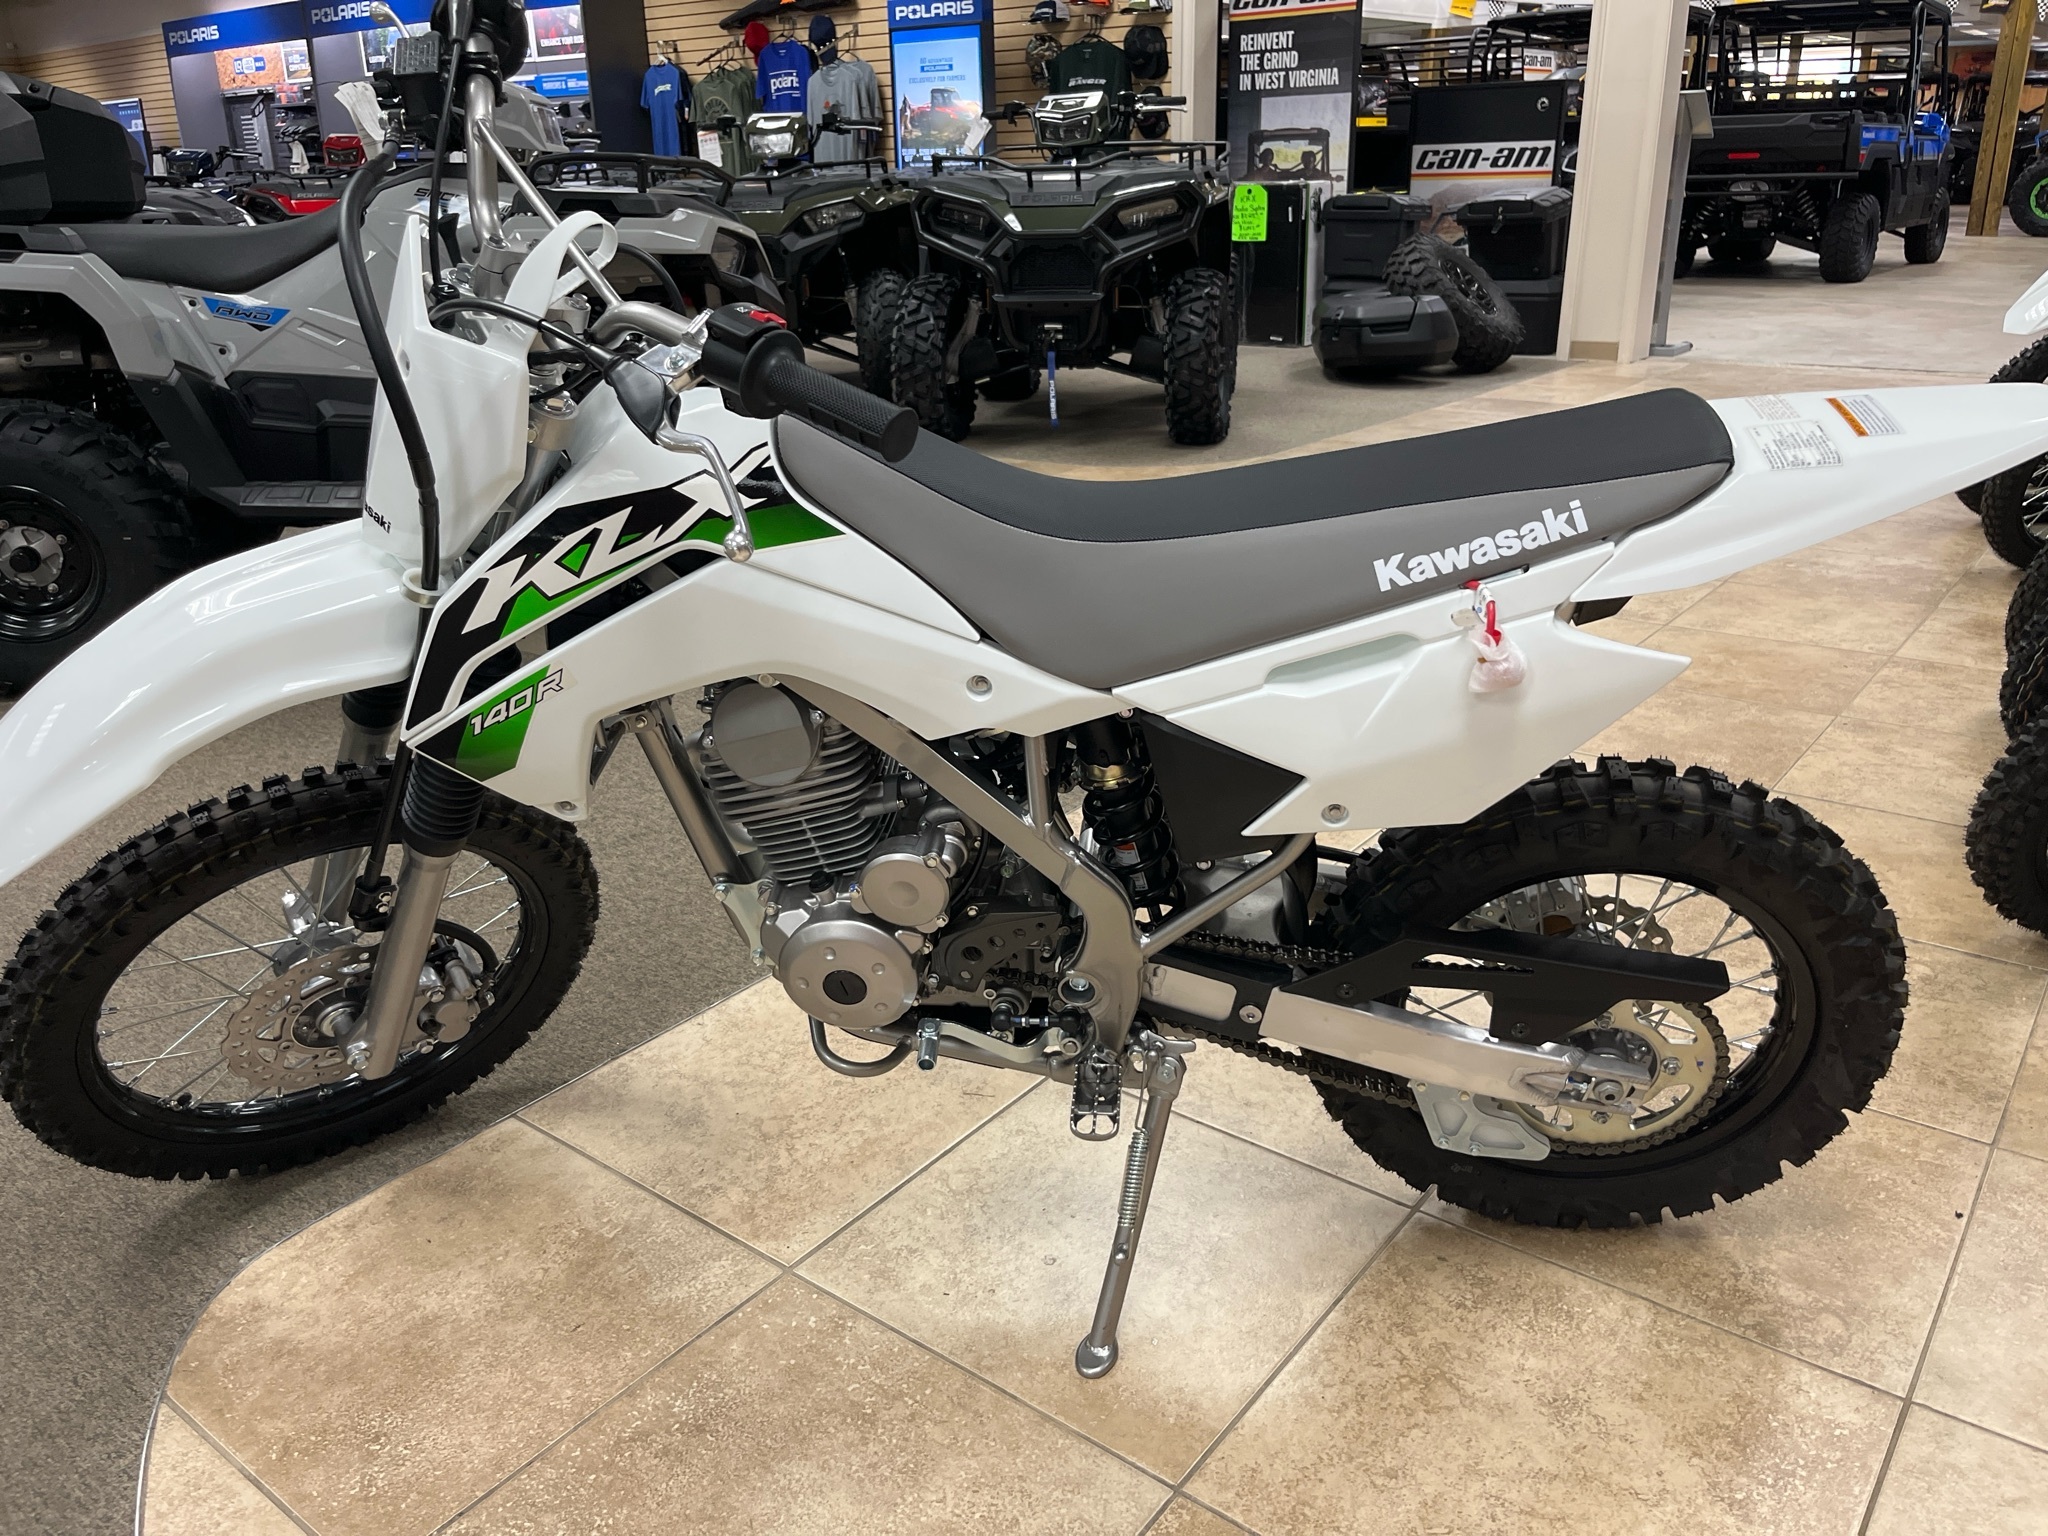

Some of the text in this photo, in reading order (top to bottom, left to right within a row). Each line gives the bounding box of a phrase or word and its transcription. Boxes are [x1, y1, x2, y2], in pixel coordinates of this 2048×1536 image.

[312, 1, 370, 24] POLARIS
[895, 0, 974, 20] POLARIS
[169, 25, 220, 46] POLARIS
[1240, 30, 1295, 52] REINVENT
[1240, 50, 1299, 72] THE GRIND
[1523, 54, 1552, 68] can-am
[1239, 67, 1339, 91] IN WEST VIRGINIA
[1415, 145, 1552, 171] can-am
[215, 306, 272, 321] AWD
[460, 442, 770, 636] KLX
[1372, 499, 1590, 593] Kawasaki
